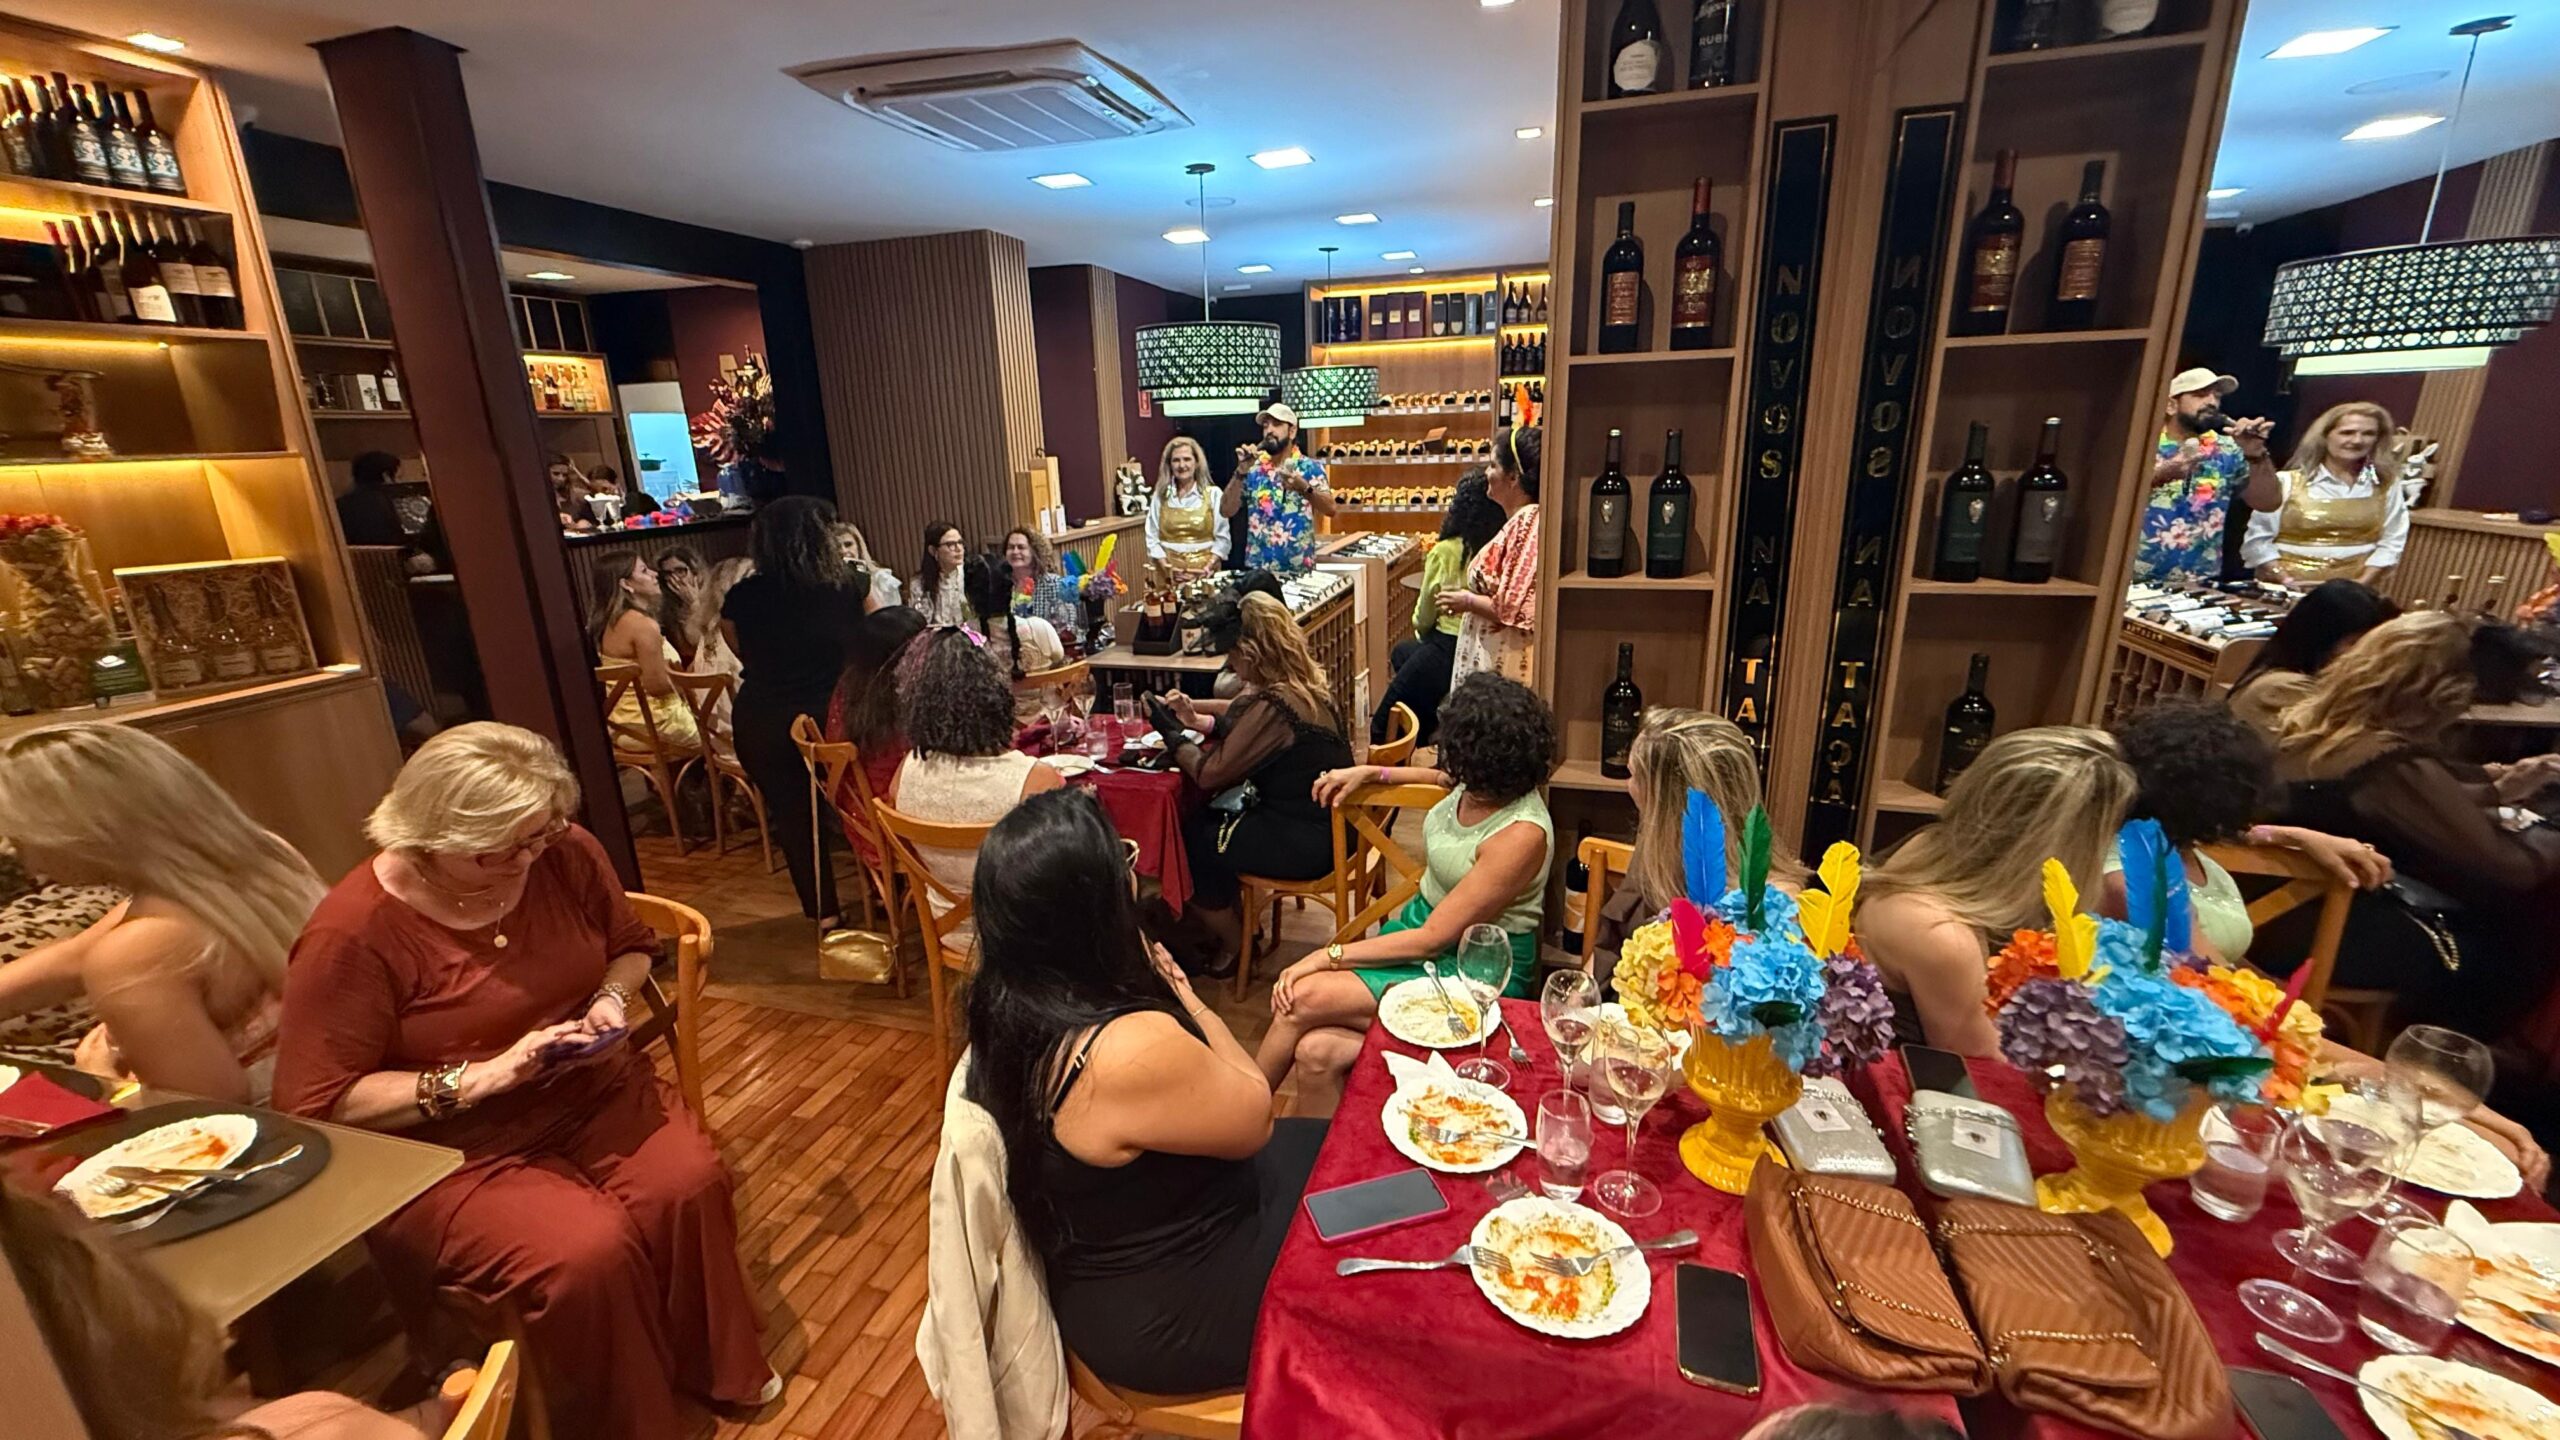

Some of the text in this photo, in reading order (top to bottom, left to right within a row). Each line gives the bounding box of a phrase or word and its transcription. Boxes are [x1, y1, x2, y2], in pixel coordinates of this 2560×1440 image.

[1735, 264, 1804, 747] NOVOS NA TA
